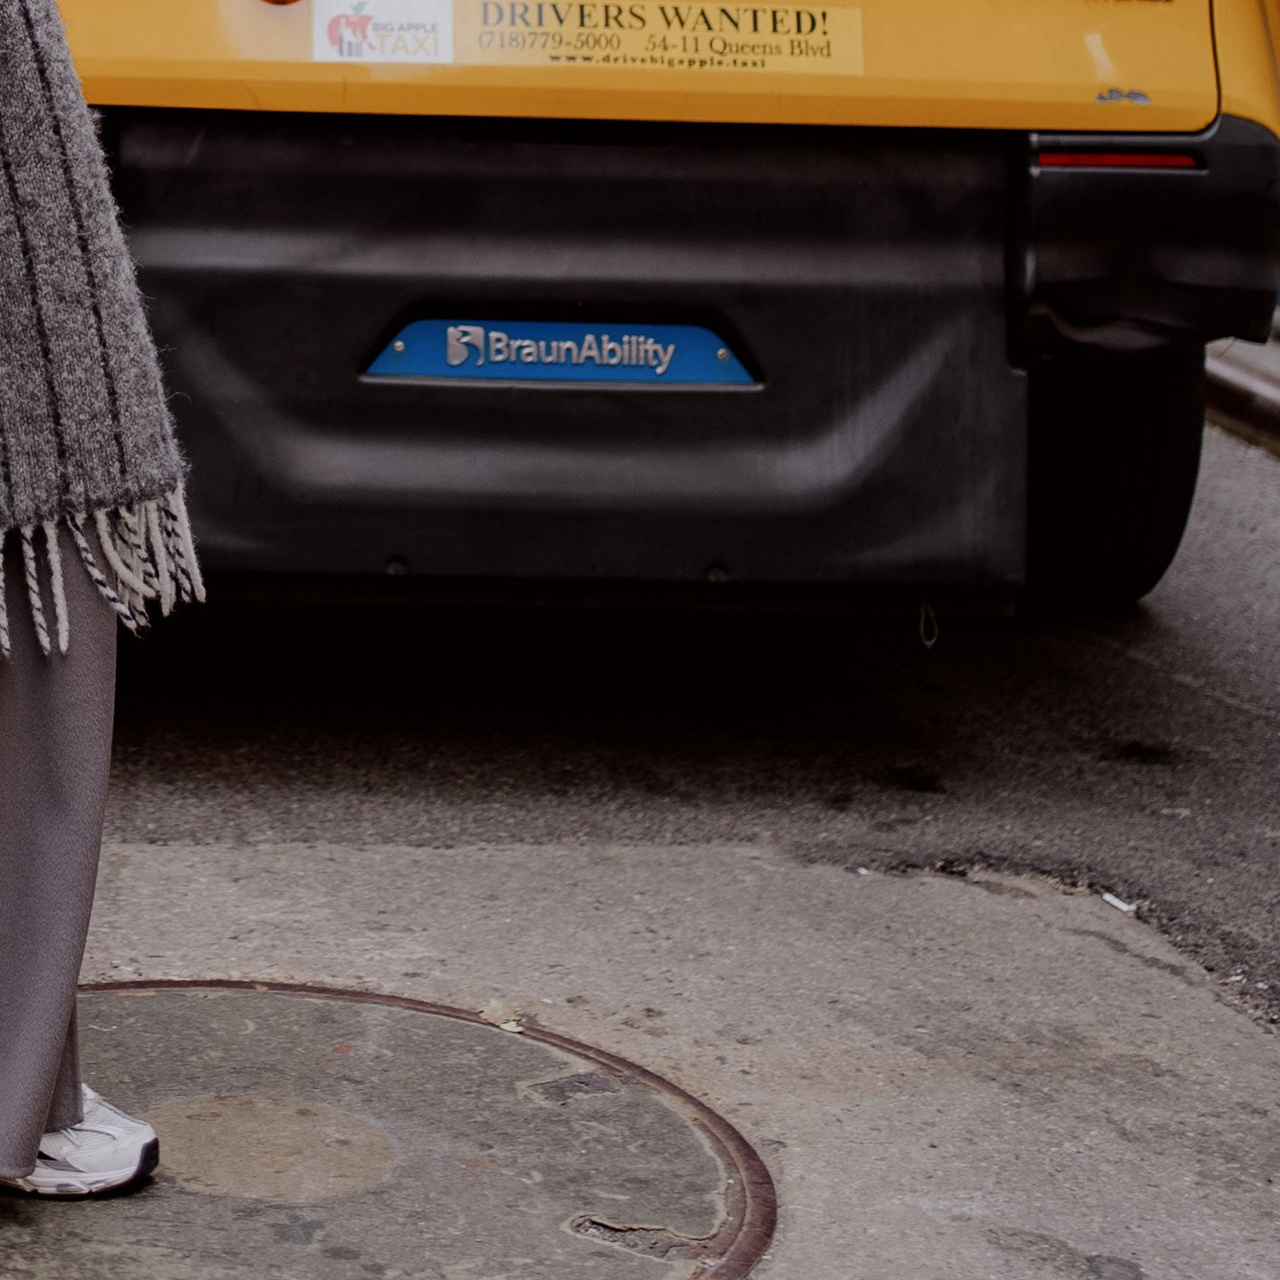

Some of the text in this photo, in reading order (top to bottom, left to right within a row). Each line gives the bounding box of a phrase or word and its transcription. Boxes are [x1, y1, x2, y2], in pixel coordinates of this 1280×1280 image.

[372, 22, 439, 34] BIG APPLE
[481, 1, 828, 36] DRIVERS WANTED!
[372, 32, 439, 57] TAXI
[478, 30, 832, 59] (718)779-5000 54-11 Queens Blvd
[549, 54, 766, 69] www.drivebigapple.taxi
[488, 330, 676, 377] BraunAbility
